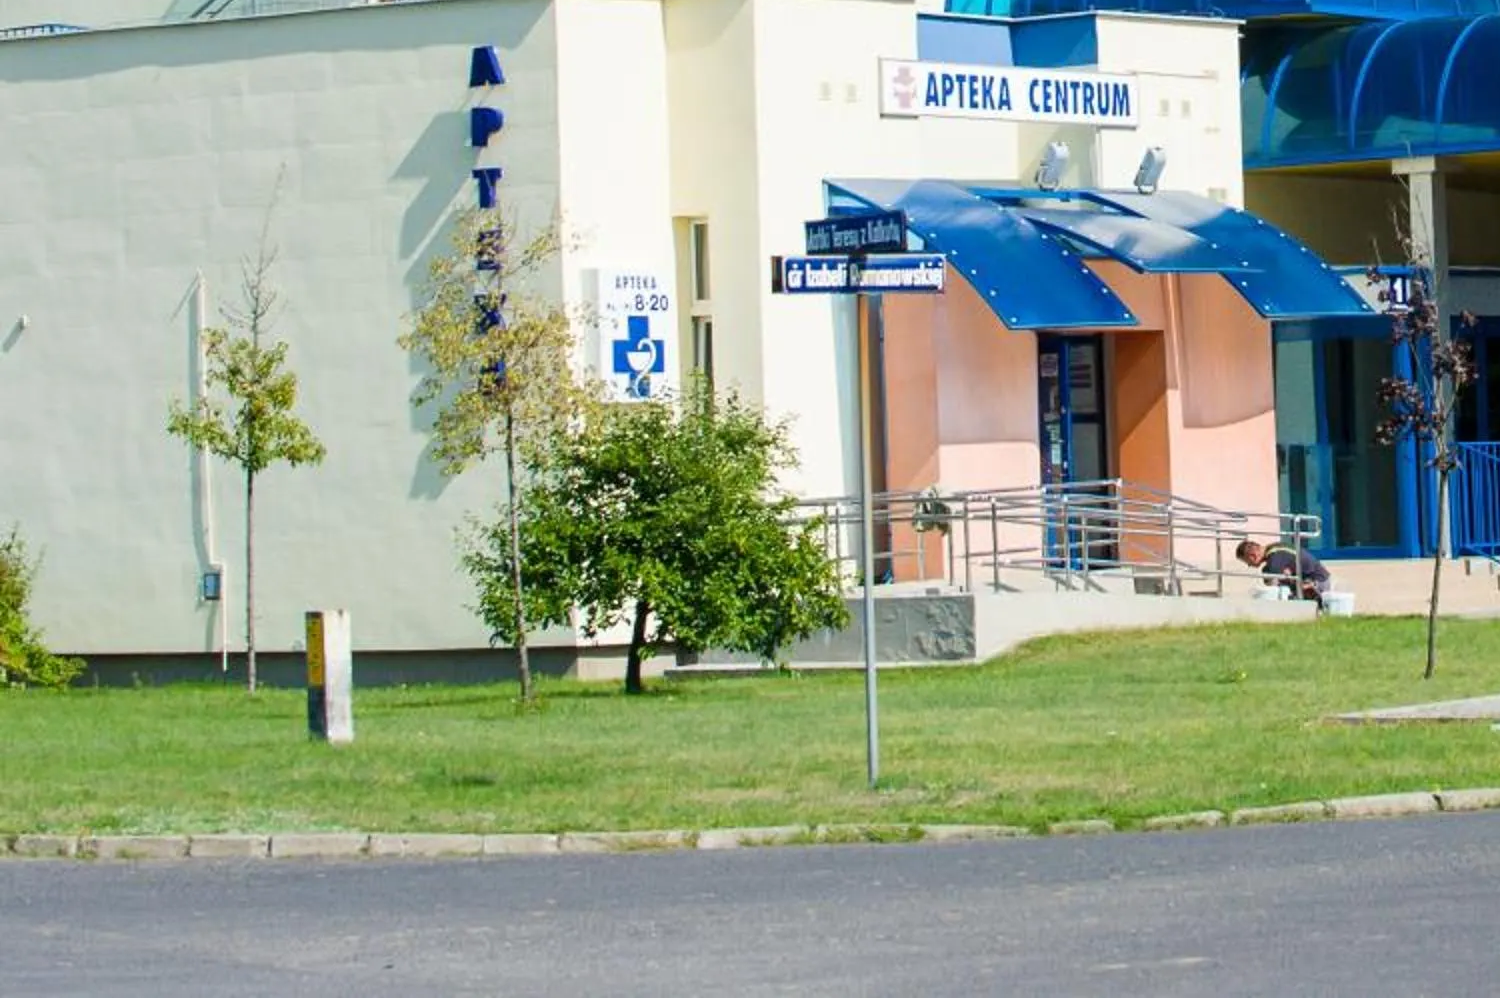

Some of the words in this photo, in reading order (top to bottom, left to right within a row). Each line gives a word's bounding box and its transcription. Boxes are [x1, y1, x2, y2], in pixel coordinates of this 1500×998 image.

[925, 71, 1012, 111] APTEKA
[1028, 78, 1131, 117] CENTRUM
[615, 274, 657, 290] APTEKA
